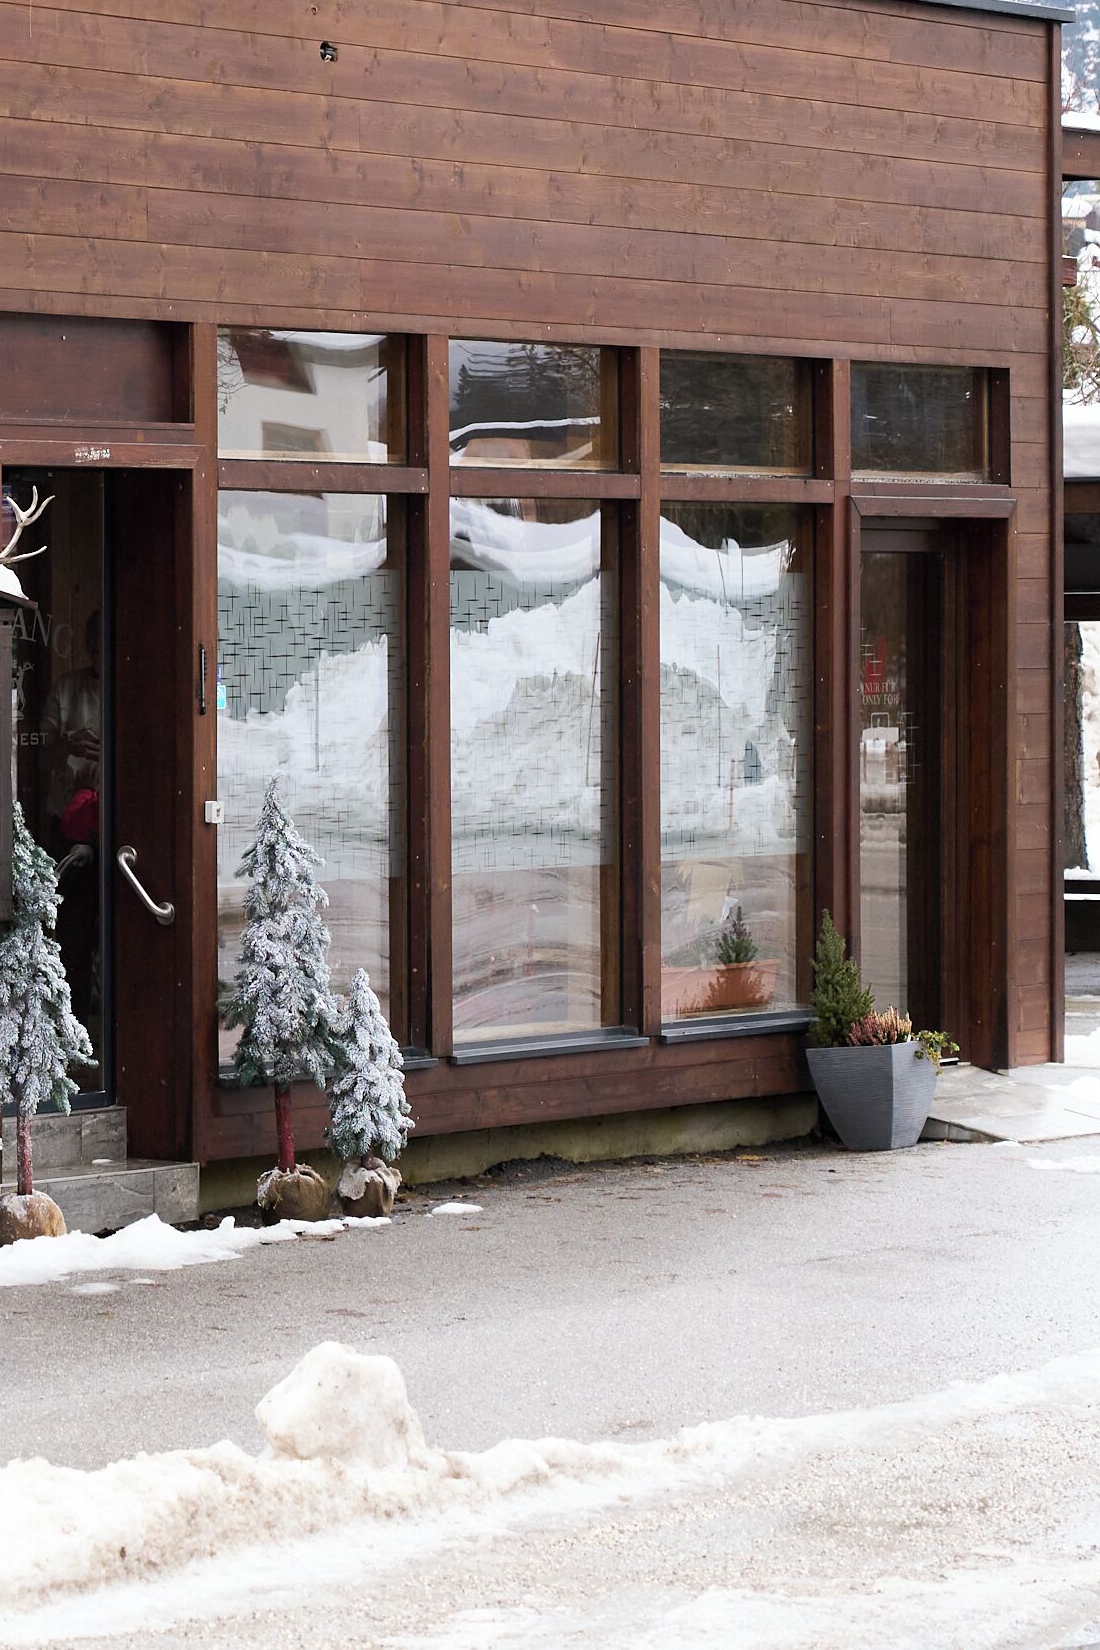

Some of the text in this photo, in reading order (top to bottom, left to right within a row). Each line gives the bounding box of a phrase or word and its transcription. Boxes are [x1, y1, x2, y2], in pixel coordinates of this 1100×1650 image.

[12, 602, 73, 659] ANG
[862, 694, 881, 706] ONLY
[12, 732, 49, 746] NEST
